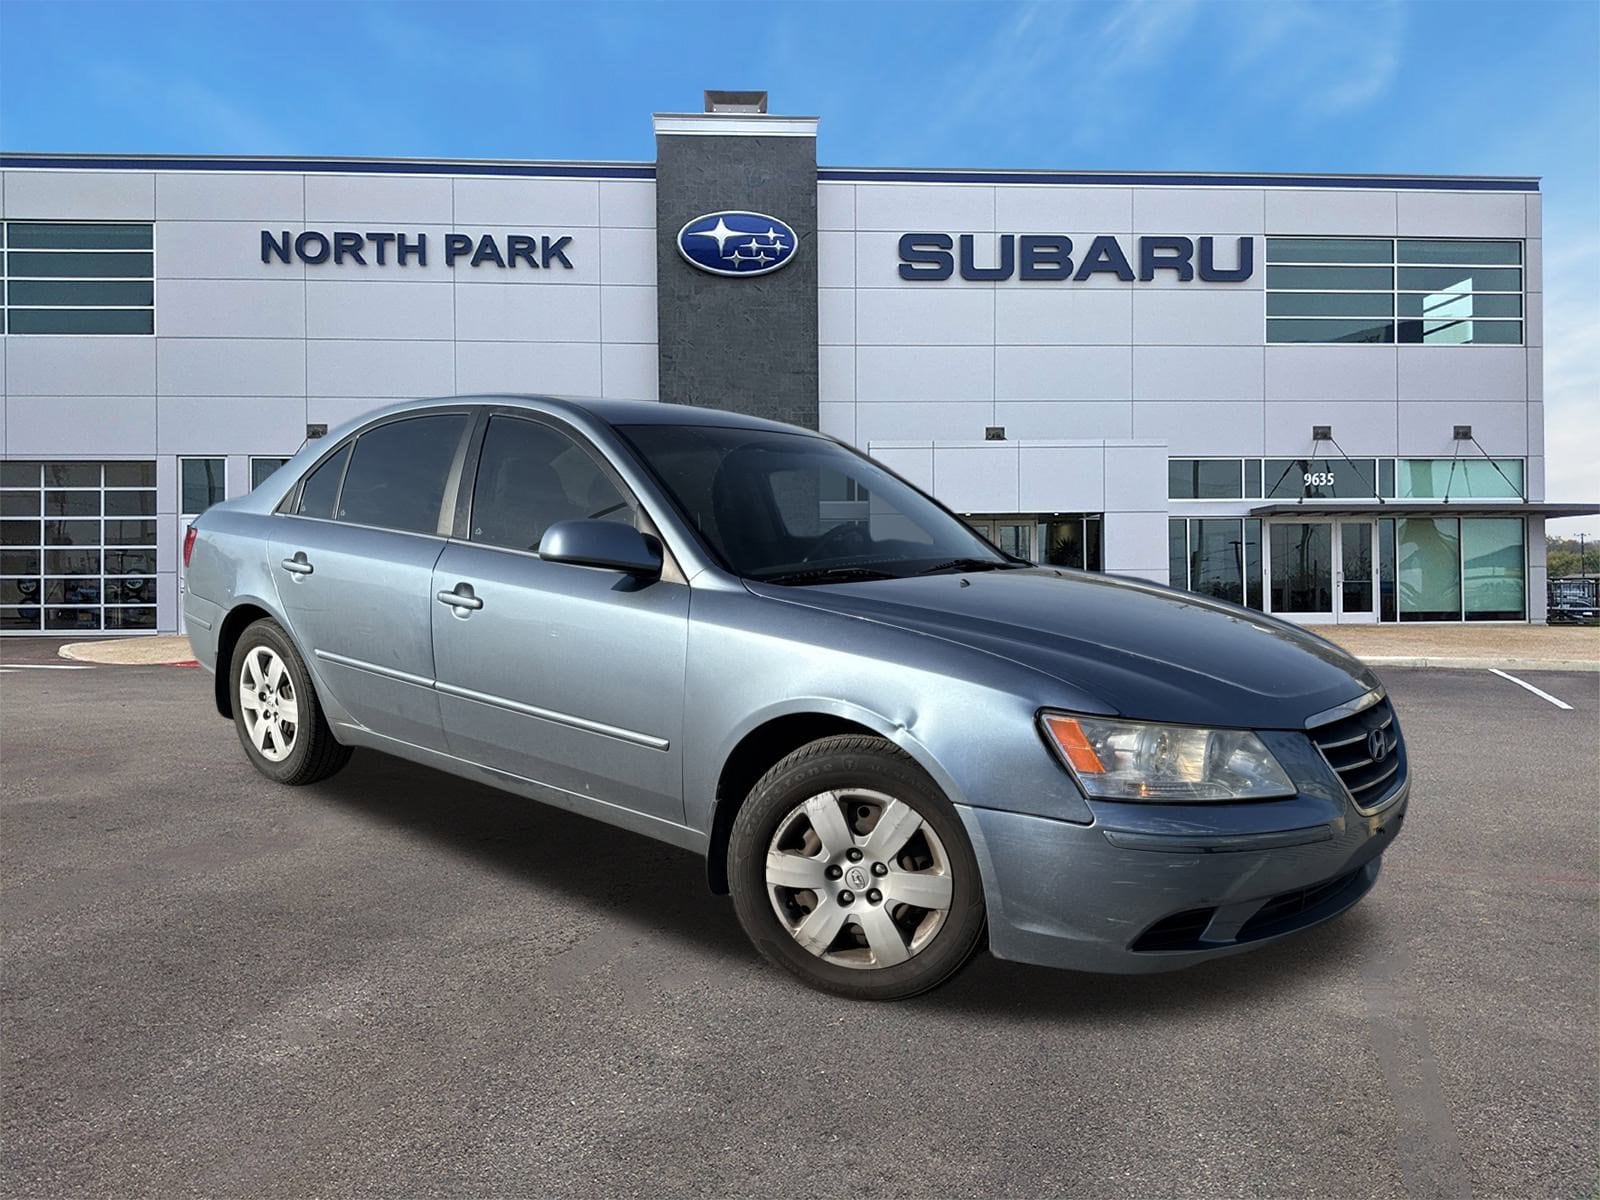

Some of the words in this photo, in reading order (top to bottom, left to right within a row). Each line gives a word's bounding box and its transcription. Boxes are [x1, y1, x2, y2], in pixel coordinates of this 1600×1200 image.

[260, 230, 427, 266] NORTH
[445, 233, 574, 269] PARK
[898, 233, 1254, 282] SUBARU
[1303, 472, 1335, 486] 9635
